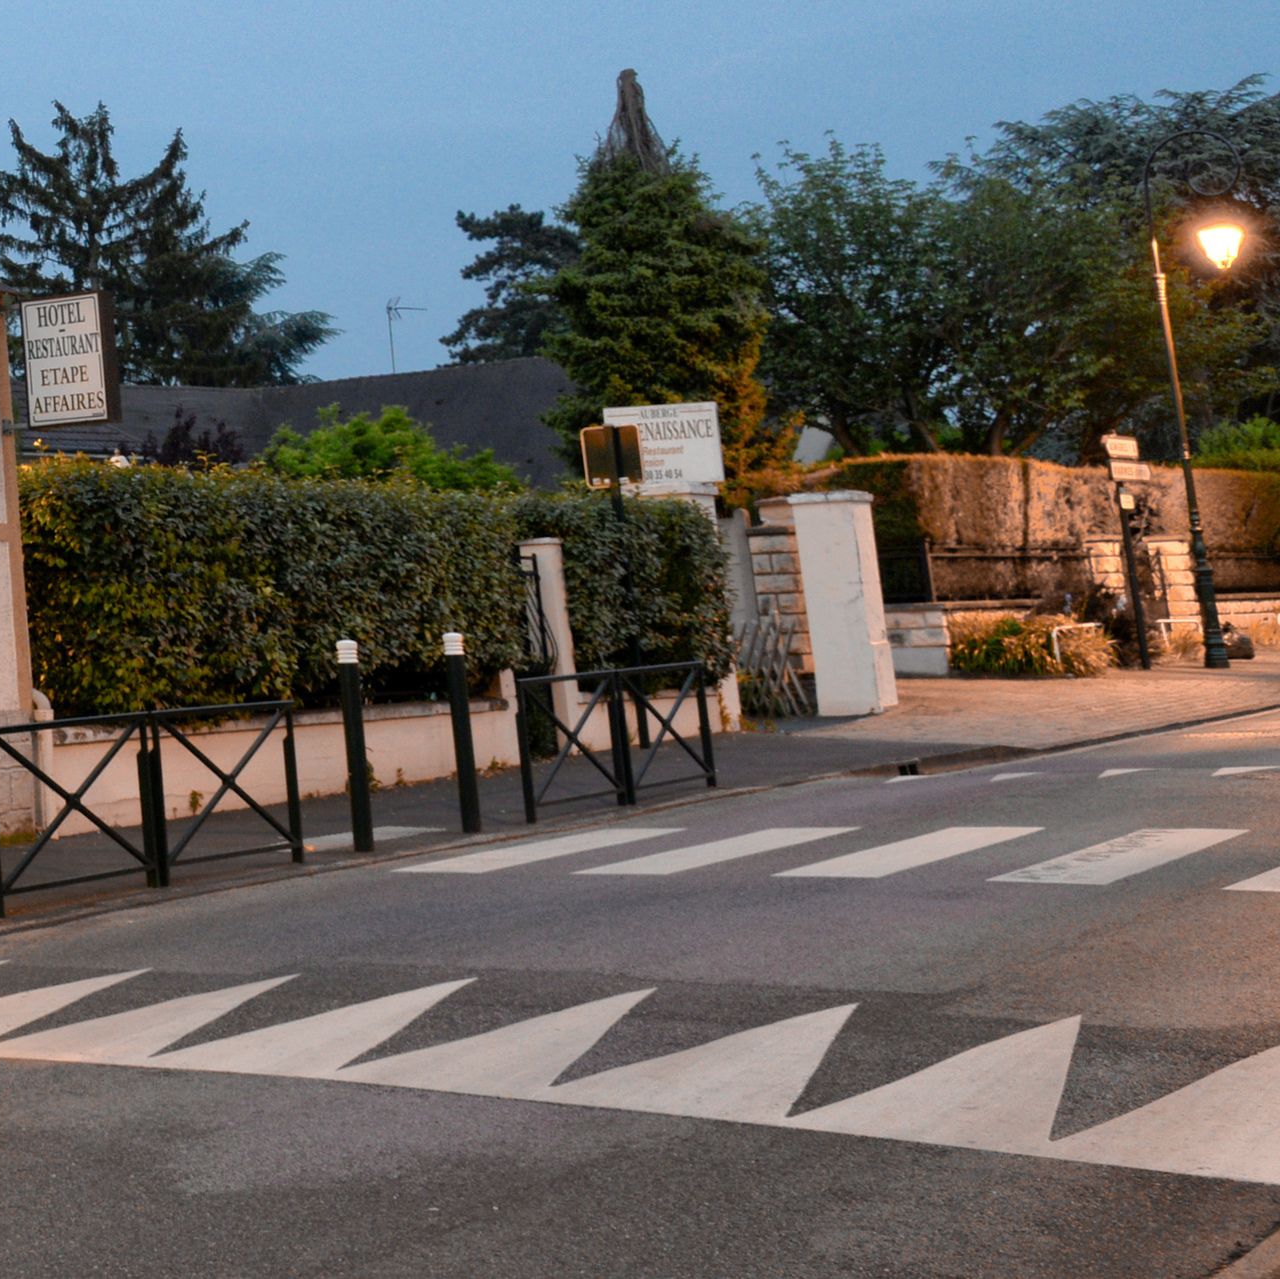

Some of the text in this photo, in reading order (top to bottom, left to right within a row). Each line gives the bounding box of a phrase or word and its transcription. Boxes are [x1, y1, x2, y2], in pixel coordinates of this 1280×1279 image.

[37, 302, 86, 327] HOTEL
[27, 333, 100, 360] RESTAURANT
[40, 365, 89, 387] ETAPE
[33, 390, 105, 415] AFFAIRES
[640, 407, 678, 419] AUBERGE
[638, 418, 713, 442] ENAISSANCE
